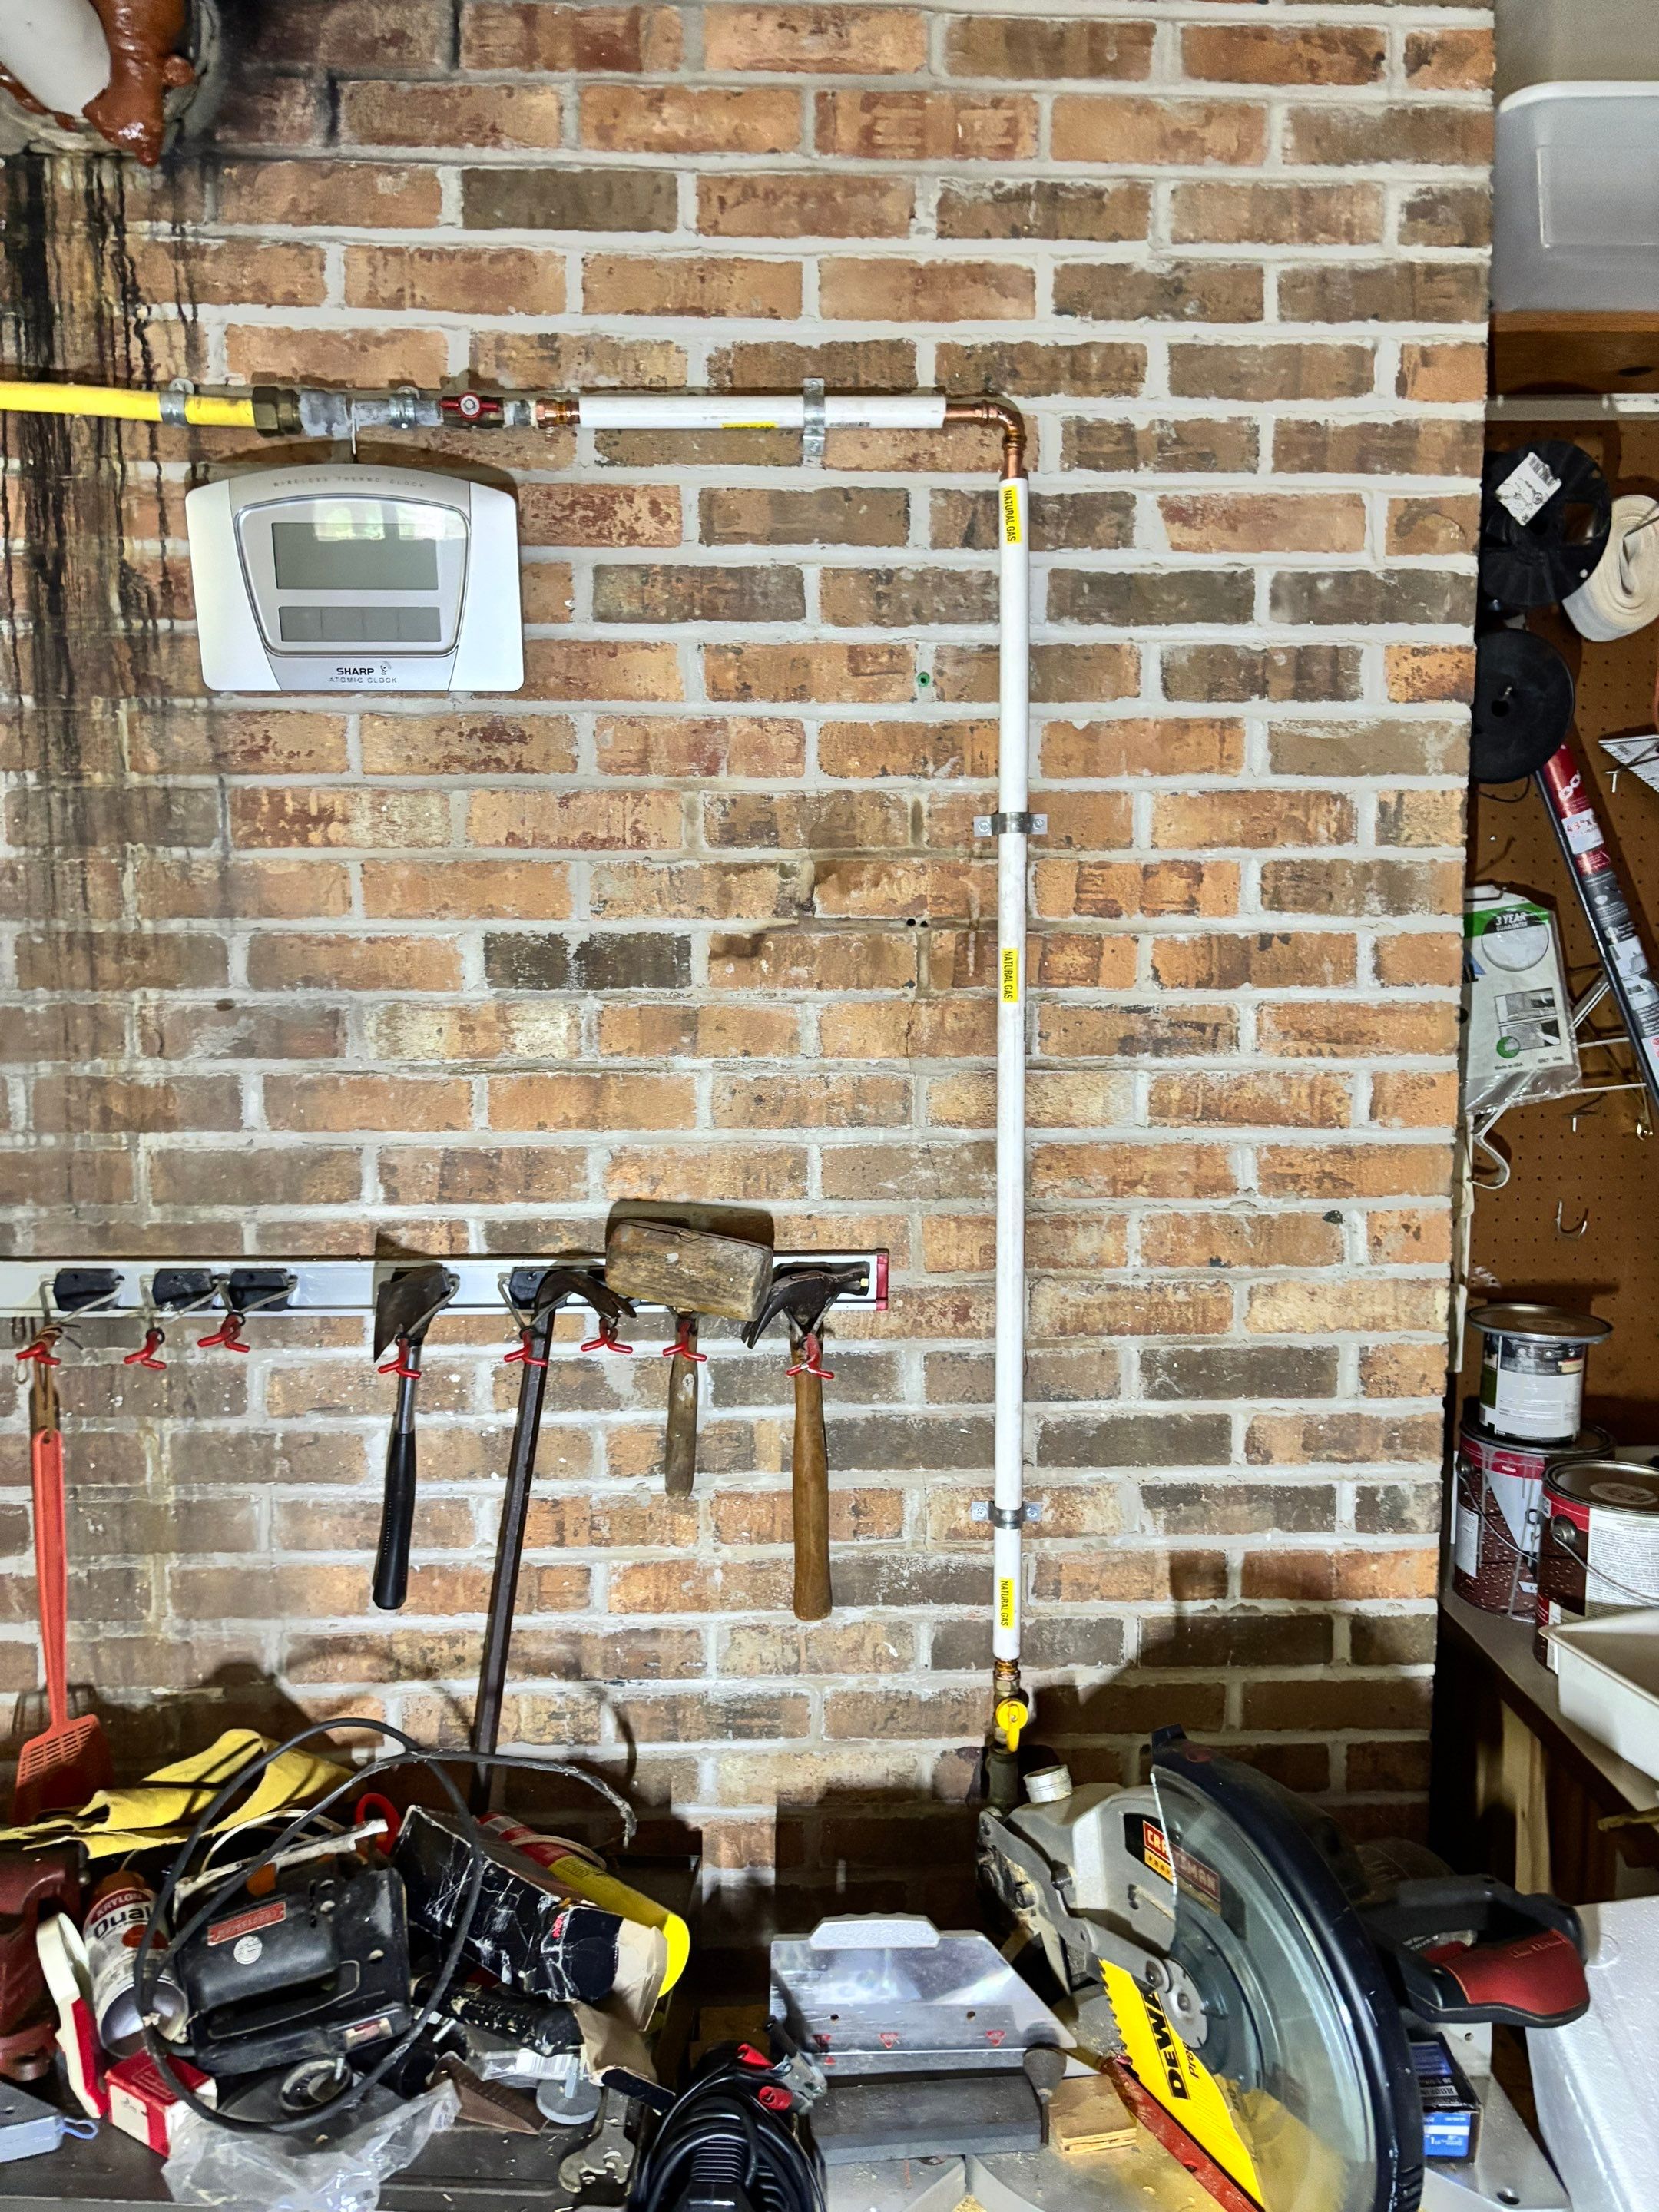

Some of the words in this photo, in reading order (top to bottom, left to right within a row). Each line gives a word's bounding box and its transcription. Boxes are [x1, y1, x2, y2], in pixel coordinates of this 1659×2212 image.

[1003, 489, 1015, 525] NATURAL
[1006, 525, 1016, 541] GAS
[1495, 916, 1502, 926] 3
[1503, 912, 1527, 925] YEAR
[1003, 951, 1013, 984] NATURAL
[1003, 985, 1013, 999] GAS
[1001, 1581, 1009, 1611] NATURAL
[1001, 1612, 1009, 1626] GAS
[95, 1892, 143, 1919] KRYLON
[94, 1906, 151, 1939] Dual
[1141, 1991, 1188, 2100] DEWA
